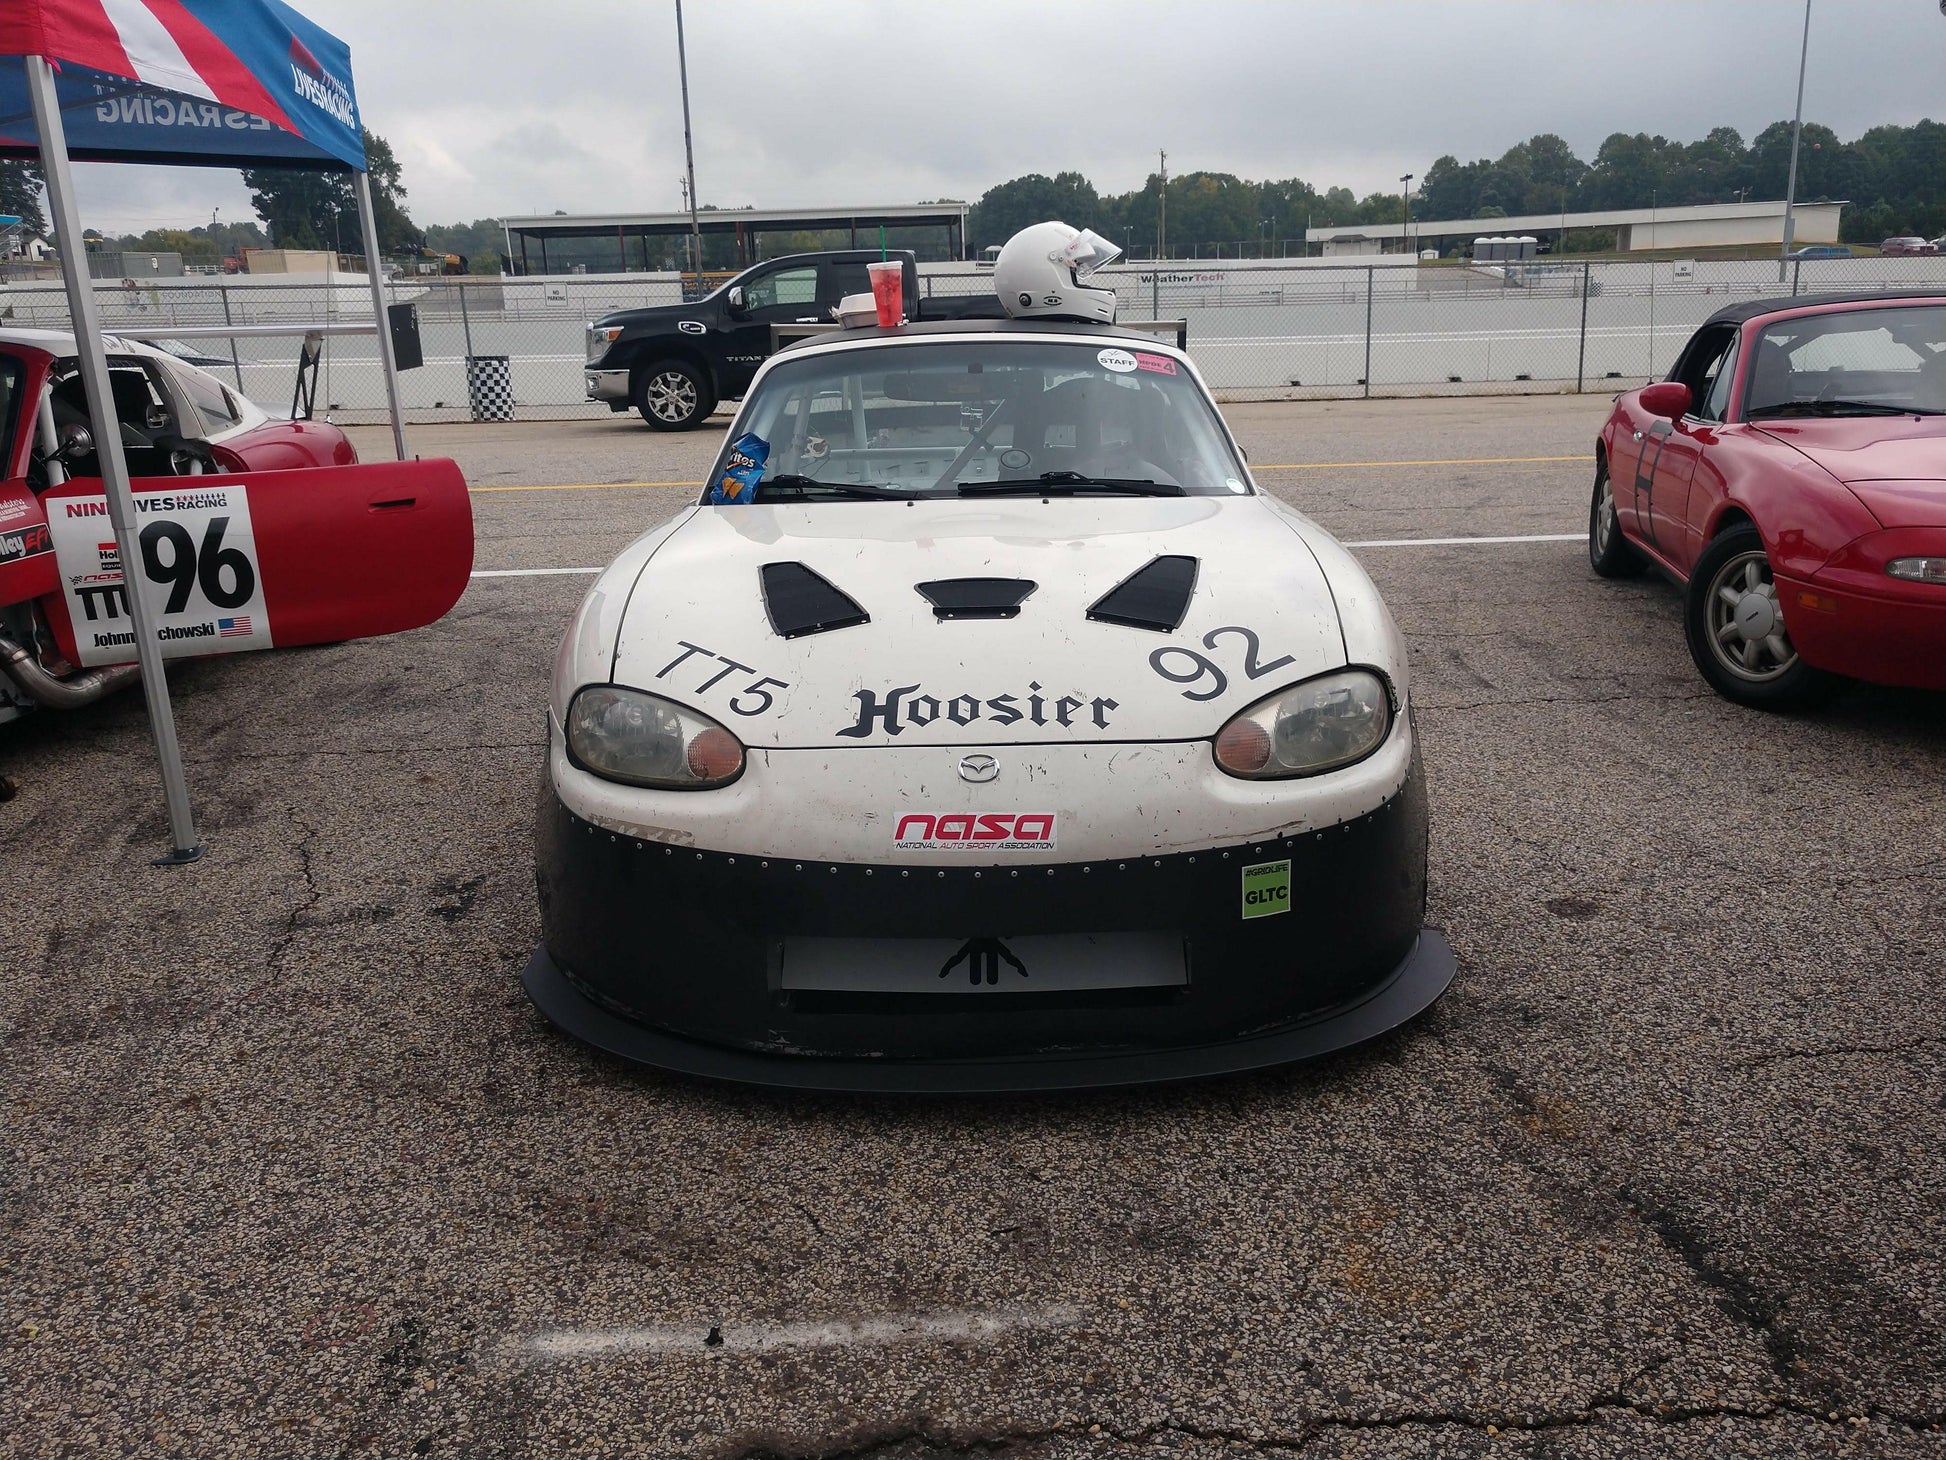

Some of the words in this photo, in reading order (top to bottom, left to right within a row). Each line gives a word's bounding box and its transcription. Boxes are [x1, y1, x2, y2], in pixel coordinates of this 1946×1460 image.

[1100, 358, 1135, 366] STAFF
[1163, 362, 1174, 374] 4
[730, 452, 756, 468] ritos
[66, 502, 110, 518] NIN
[176, 498, 228, 510] RACING
[99, 550, 118, 560] Hol
[138, 516, 255, 614] 96
[93, 632, 136, 647] Johnn
[157, 622, 215, 641] chowski
[1148, 626, 1297, 701] 92
[655, 640, 790, 717] TT5
[835, 680, 1120, 738] Hoosier
[894, 814, 1055, 841] nasa
[1245, 864, 1288, 877] #GRIDLIFE
[1245, 885, 1288, 905] GLTC
